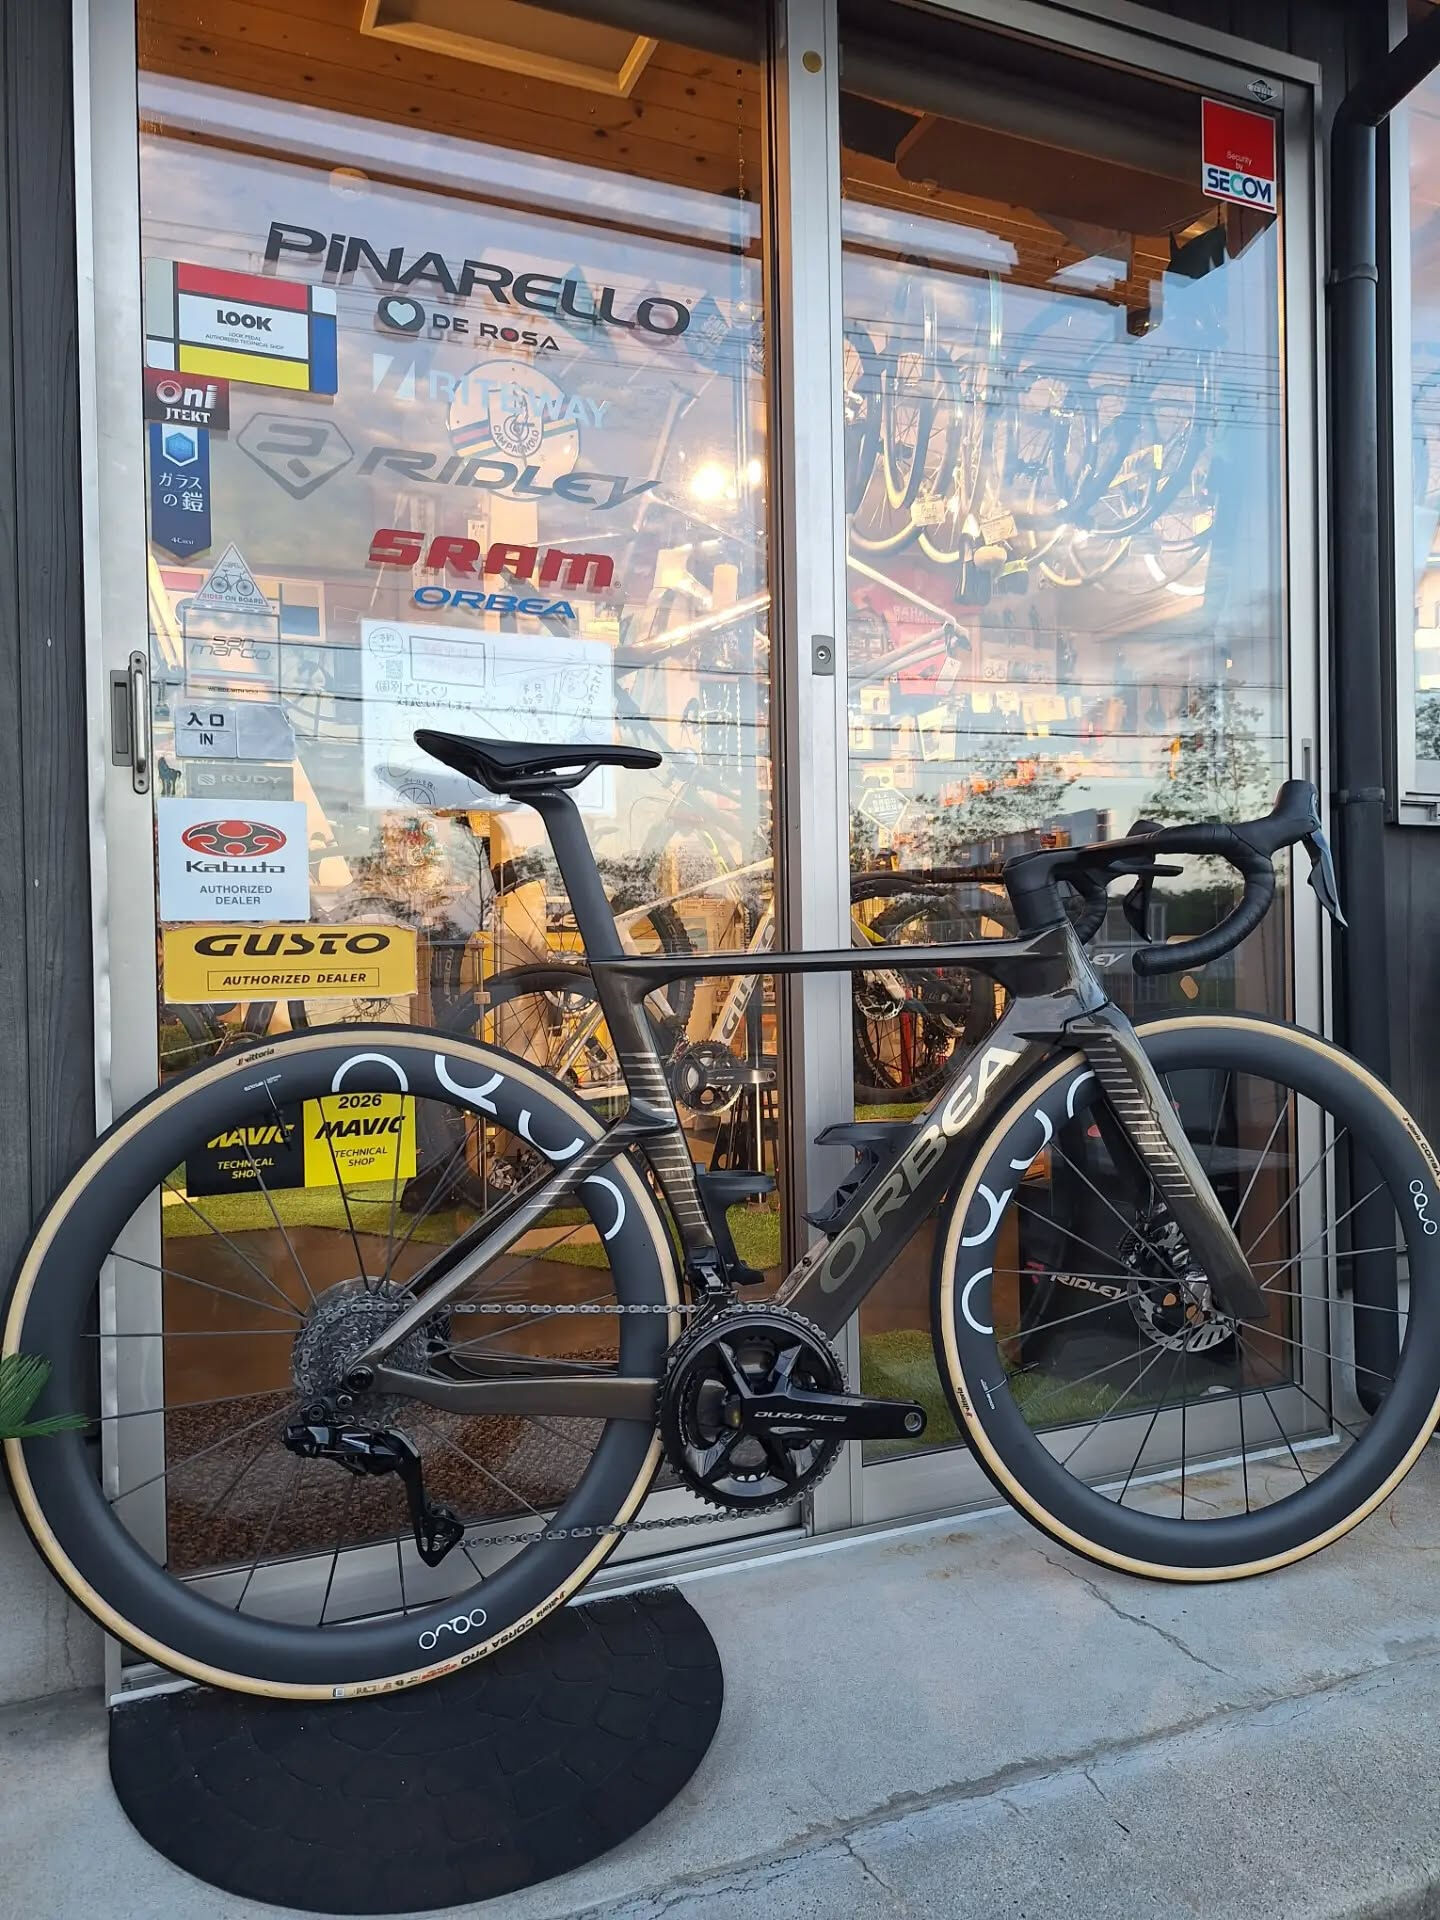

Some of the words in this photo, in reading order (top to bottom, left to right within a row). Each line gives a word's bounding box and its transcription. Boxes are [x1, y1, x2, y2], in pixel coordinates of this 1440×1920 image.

[1226, 150, 1252, 166] Security
[1207, 167, 1271, 203] SECOM
[216, 309, 272, 332] LOOK
[432, 313, 469, 334] DE
[480, 322, 561, 351] ROSA
[429, 369, 609, 428] RITEWAY
[165, 407, 210, 423] JTEKT
[493, 424, 540, 455] CAMPAGNOLO
[159, 472, 202, 490] ガラス
[357, 447, 663, 511] RIDLEY
[163, 491, 204, 513] の鎧
[414, 587, 576, 619] ORBEA
[187, 712, 225, 727] 入口
[199, 733, 214, 746] IN
[221, 774, 283, 784] RUDY
[186, 860, 286, 874] Kabuto
[199, 884, 273, 896] AUTHORIZED
[214, 895, 262, 906] DEALER
[194, 932, 390, 956] GUSTO
[222, 973, 311, 986] AUTHORIZED
[316, 972, 367, 985] DEALER
[337, 1094, 382, 1110] 2026
[314, 1115, 407, 1140] MAVIC
[207, 1124, 295, 1149] MAVIC
[334, 1145, 388, 1159] TECHNICAL
[217, 1157, 275, 1170] TECHNCAL
[347, 1157, 376, 1168] SHOP
[819, 1046, 1023, 1294] ORBEA
[231, 1168, 262, 1180] SHOP
[1050, 1273, 1128, 1300] RIDLEY
[754, 1411, 848, 1422] DURA-ACE
[460, 1646, 488, 1665] PRO
